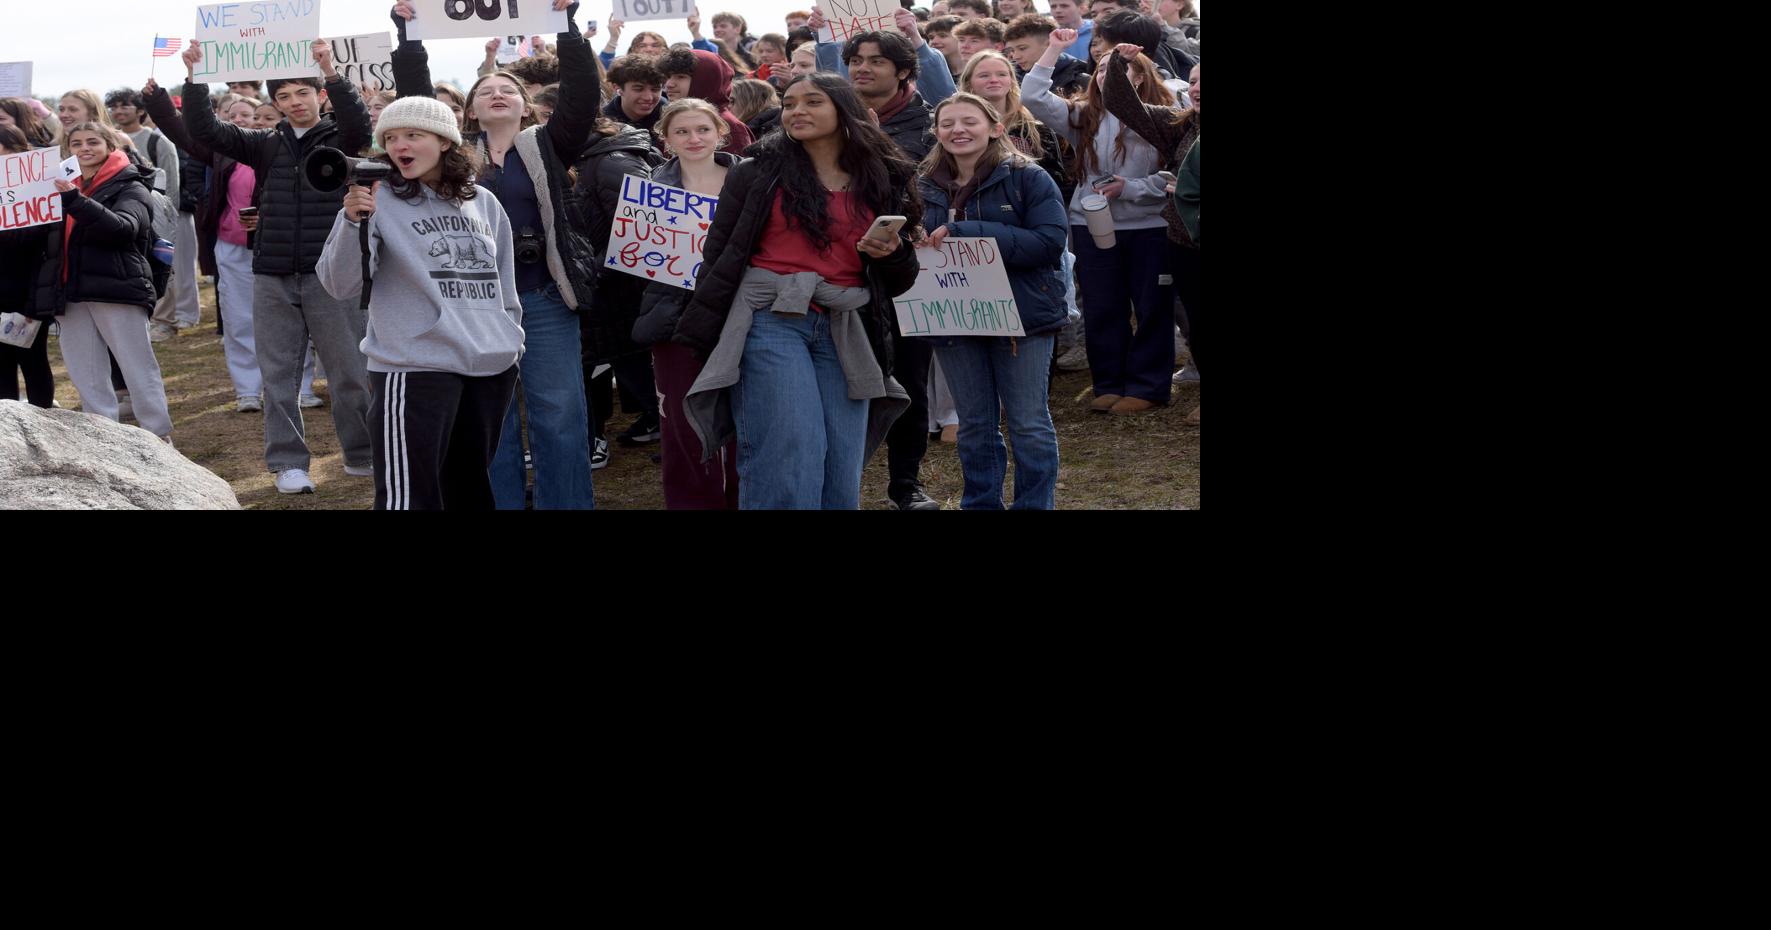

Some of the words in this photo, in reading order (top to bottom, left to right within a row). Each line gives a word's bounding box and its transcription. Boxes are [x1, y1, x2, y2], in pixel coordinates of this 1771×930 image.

[198, 4, 240, 28] WE
[250, 0, 314, 25] STAND
[240, 27, 265, 38] WITH
[331, 36, 370, 63] UE
[0, 148, 57, 188] ENCE
[0, 192, 61, 228] LENCE
[623, 206, 658, 225] and
[411, 216, 492, 236] CALIFORNIA
[935, 239, 995, 268] STAND
[438, 281, 496, 299] REPUBLIC
[935, 272, 970, 289] WITH
[894, 298, 1020, 334] IMMIGRANTS
